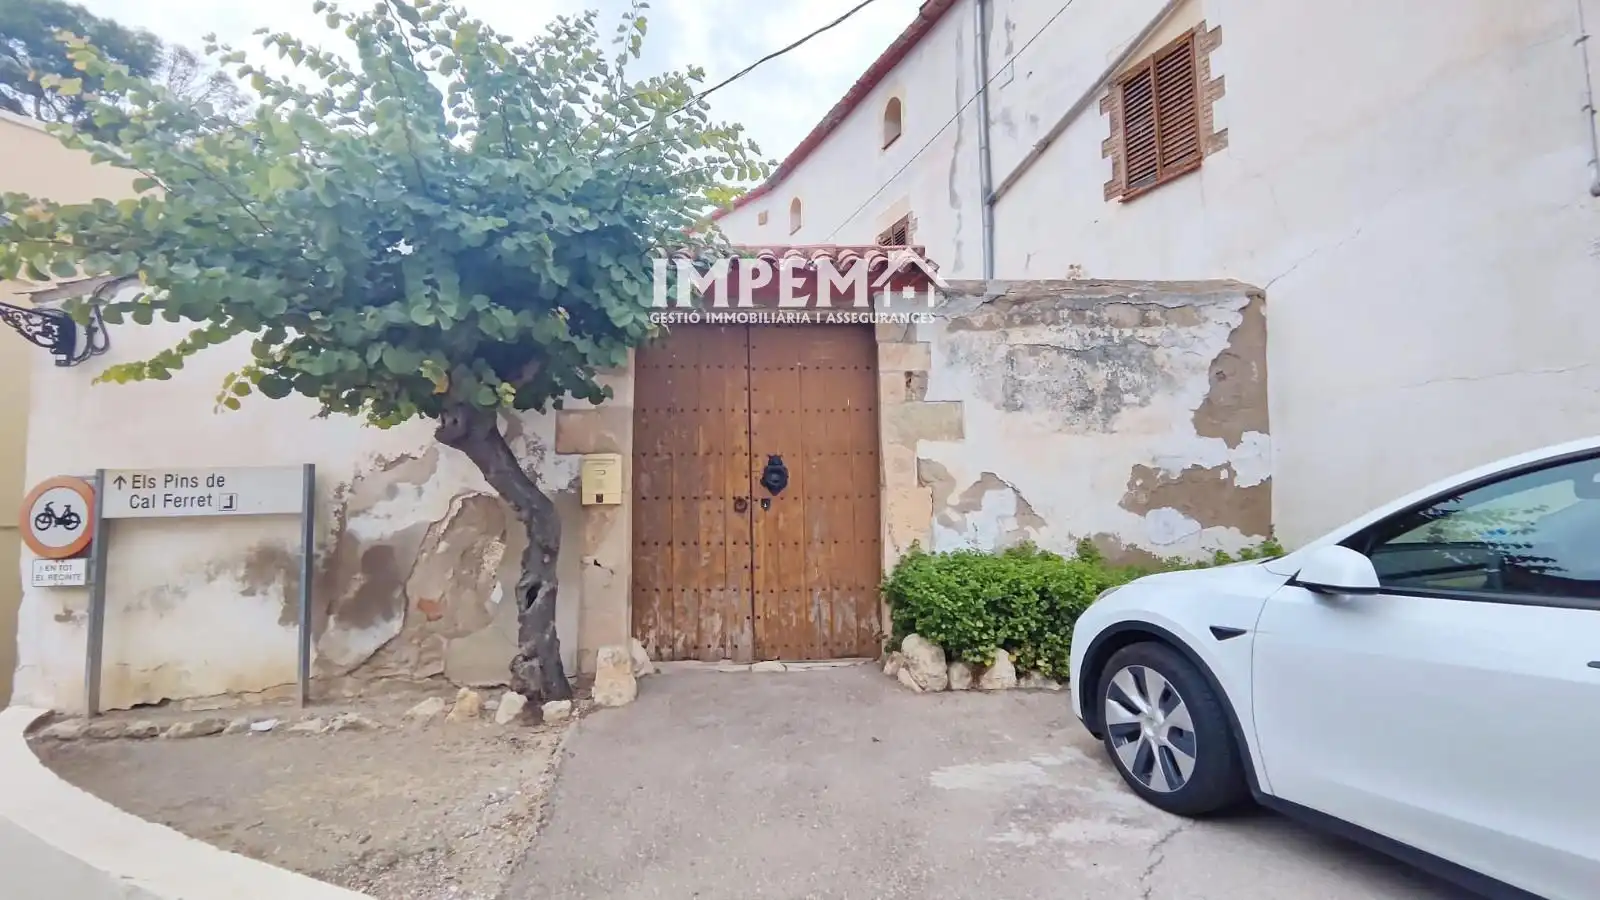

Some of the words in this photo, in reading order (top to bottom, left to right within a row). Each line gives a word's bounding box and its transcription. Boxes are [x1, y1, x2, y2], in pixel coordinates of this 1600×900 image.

[131, 474, 157, 489] Els
[164, 473, 199, 489] Pins
[206, 472, 226, 488] de
[129, 493, 156, 509] Cal
[163, 492, 213, 508] Ferret
[44, 564, 57, 572] EN
